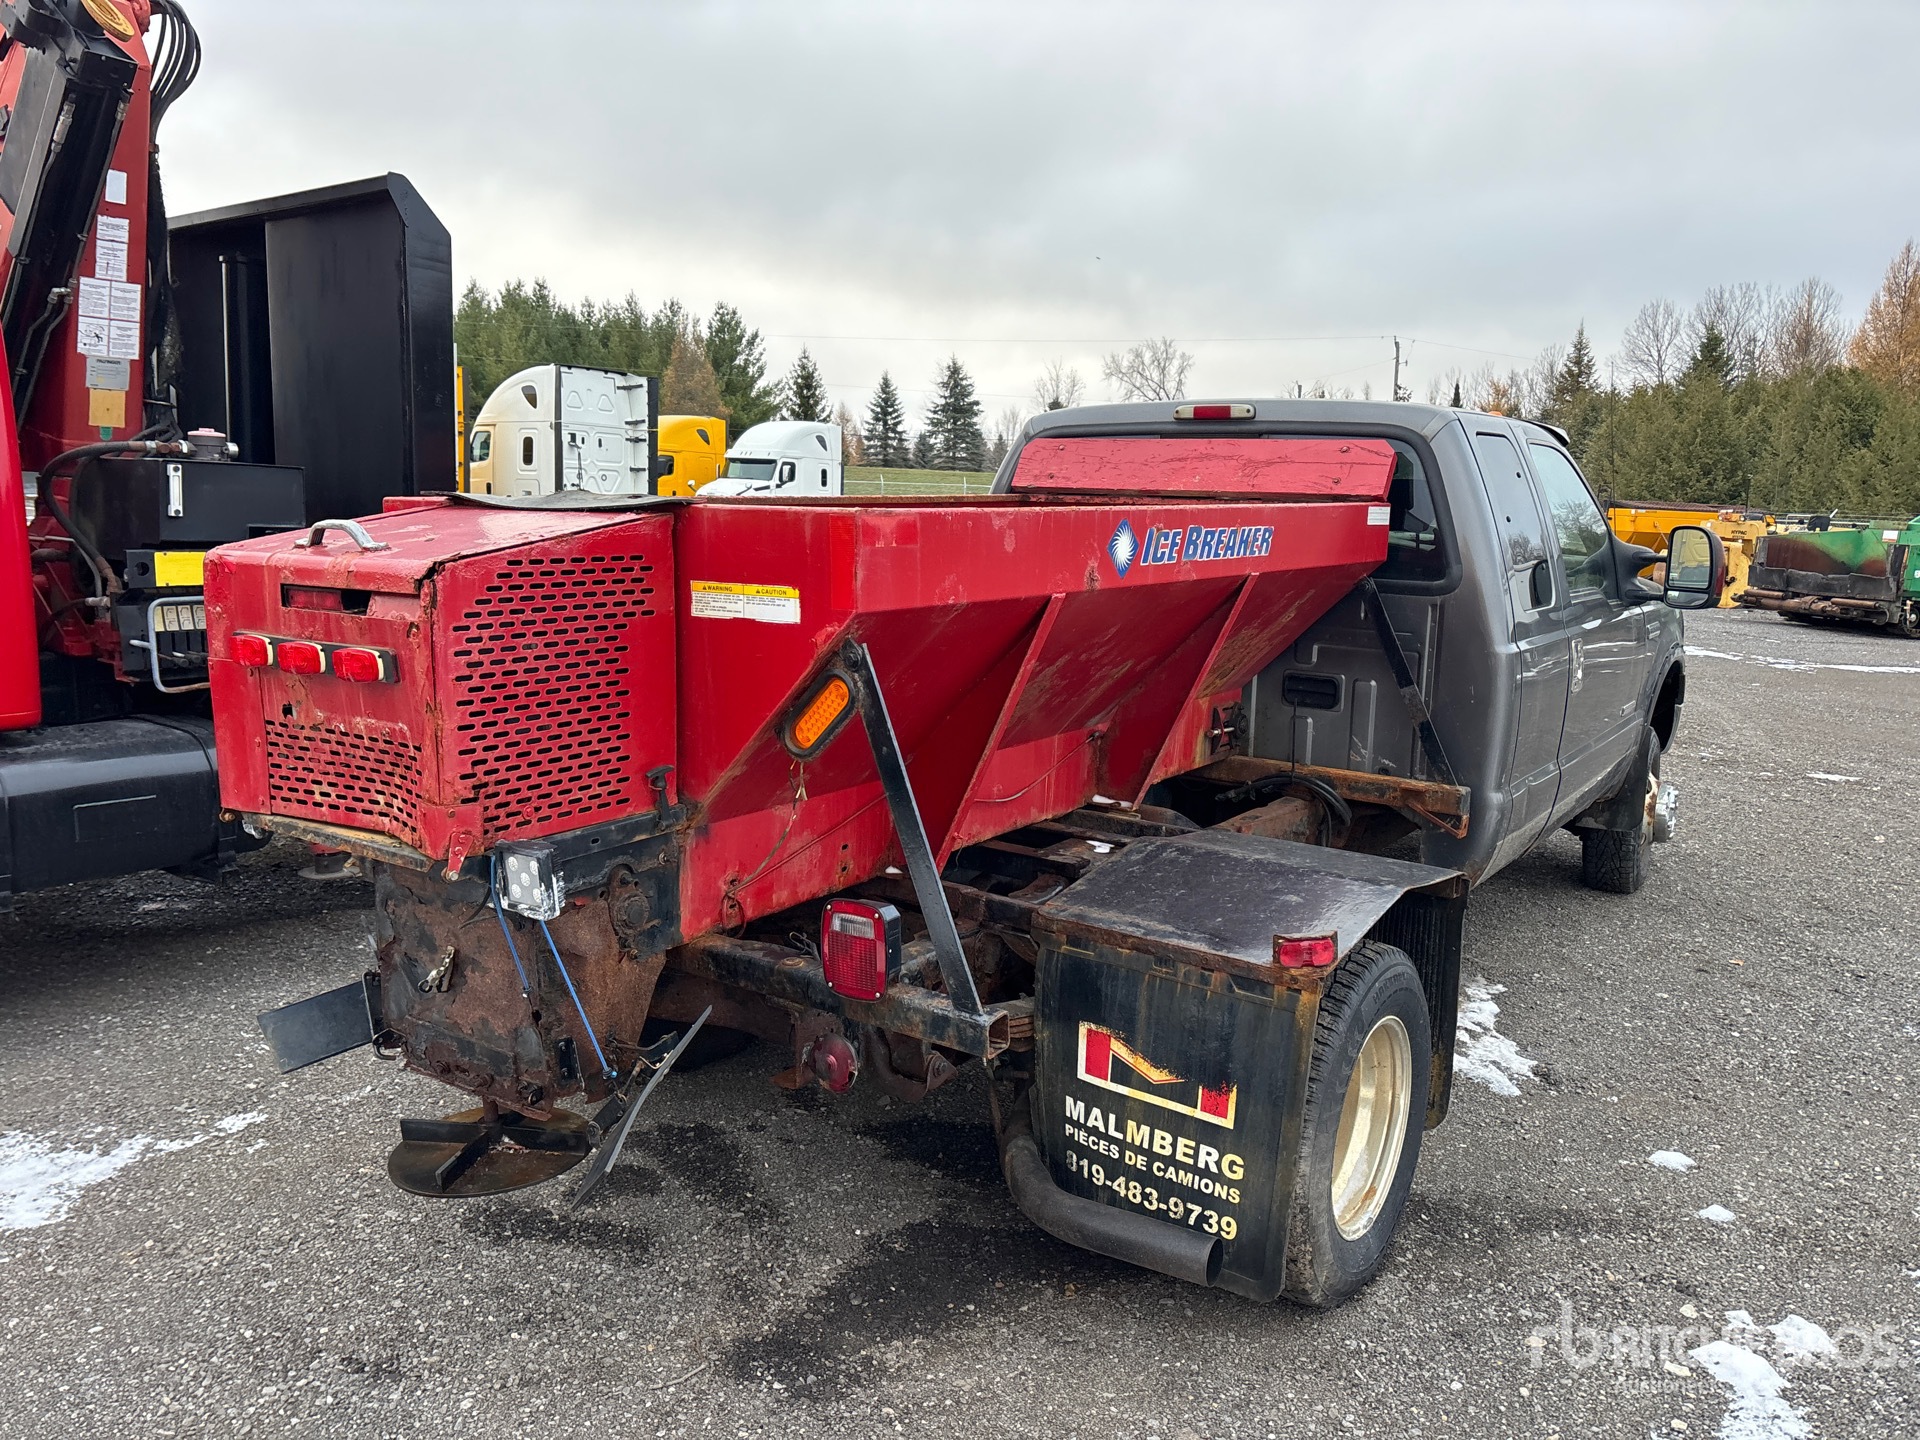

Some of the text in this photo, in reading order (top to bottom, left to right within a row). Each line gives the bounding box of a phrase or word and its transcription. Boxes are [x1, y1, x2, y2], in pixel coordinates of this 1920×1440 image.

[1140, 525, 1275, 566] ICE BREAKER
[1065, 1095, 1245, 1181] MALMBERG
[1065, 1123, 1241, 1204] PIÈCES DE CAMIONS
[1066, 1150, 1239, 1241] 819-483-9739
